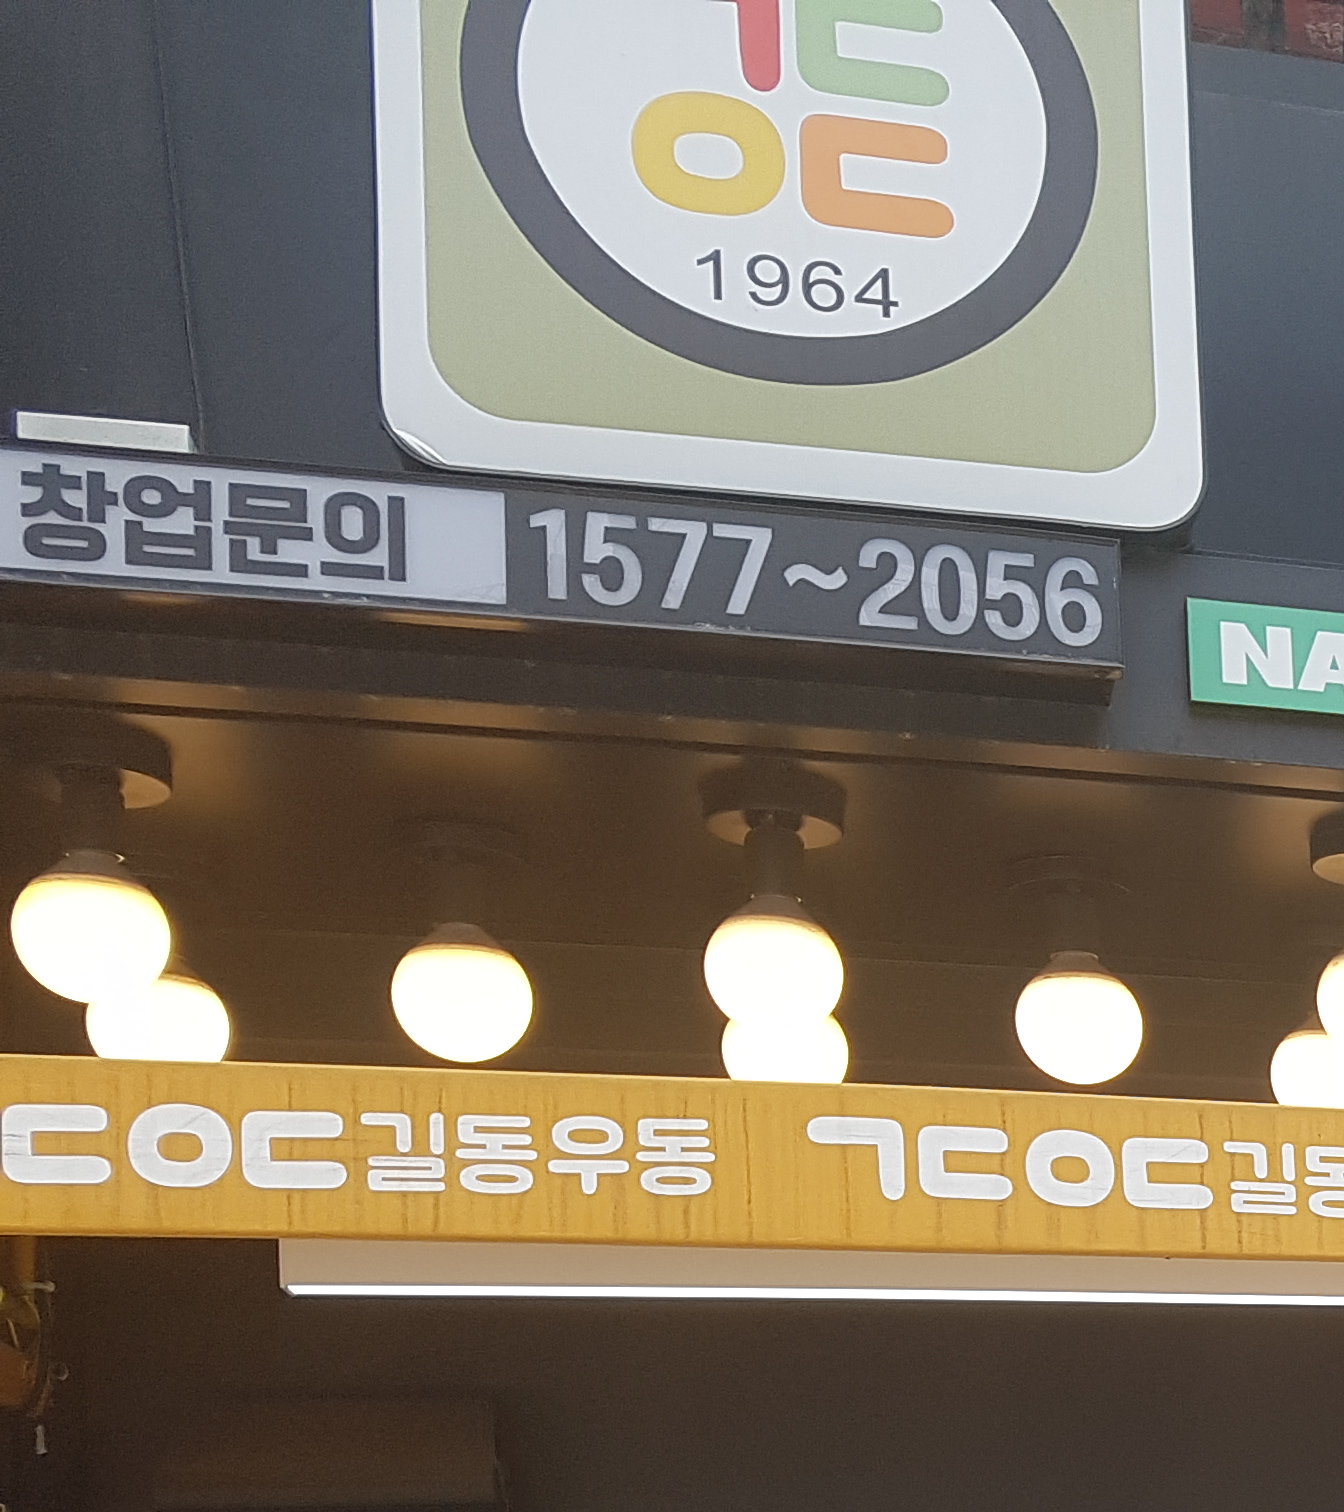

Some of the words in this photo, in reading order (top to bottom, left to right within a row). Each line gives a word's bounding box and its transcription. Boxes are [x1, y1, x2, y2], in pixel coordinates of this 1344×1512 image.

[696, 247, 900, 319] 1964
[18, 464, 406, 584] 창업문의
[528, 509, 1103, 648] 1577~2056
[360, 1111, 716, 1197] 길동우동
